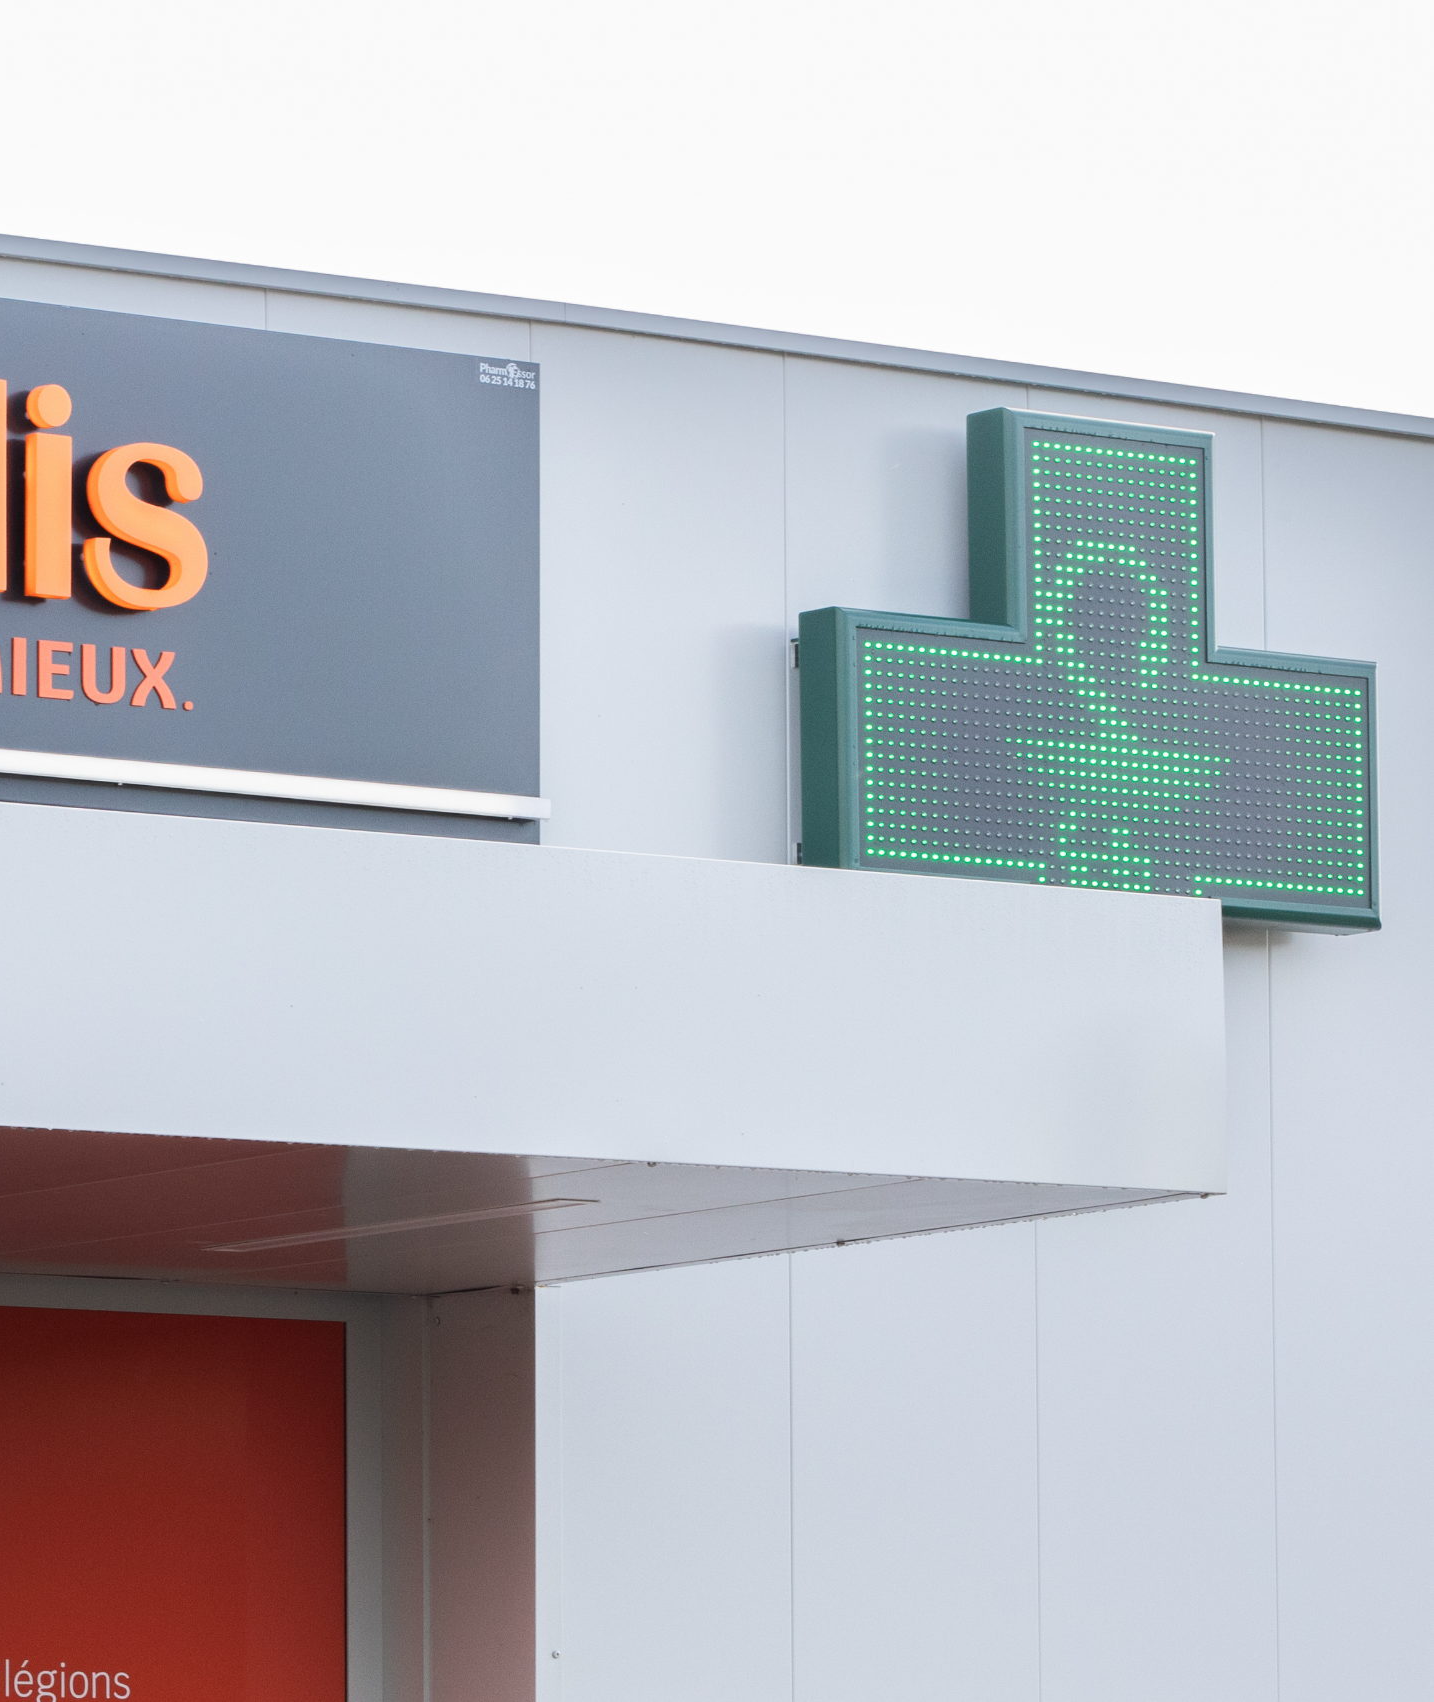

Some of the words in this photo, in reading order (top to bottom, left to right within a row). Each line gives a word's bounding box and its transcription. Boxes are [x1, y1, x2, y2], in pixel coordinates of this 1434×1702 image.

[479, 374, 491, 384] 06
[491, 375, 502, 385] 25
[502, 377, 513, 387] 14
[514, 379, 525, 388] 18
[525, 380, 536, 390] 76
